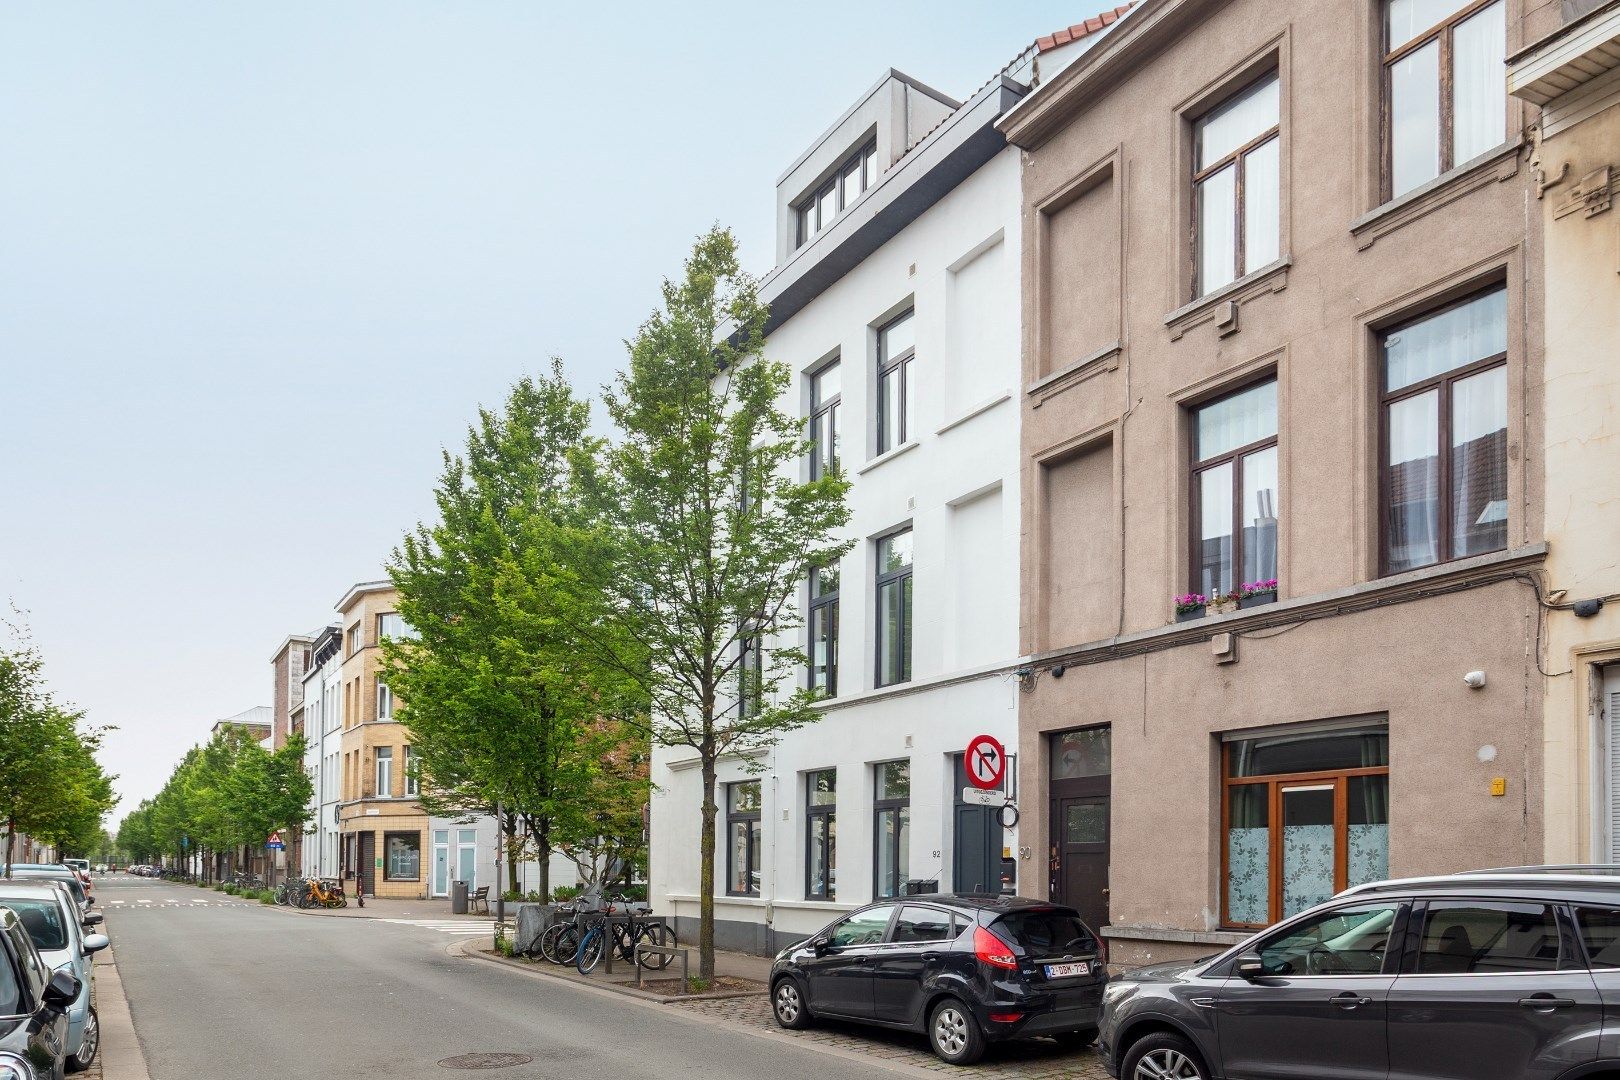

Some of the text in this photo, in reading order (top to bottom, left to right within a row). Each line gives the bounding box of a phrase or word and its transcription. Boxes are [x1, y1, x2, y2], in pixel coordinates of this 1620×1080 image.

[932, 850, 941, 858] 92
[1020, 846, 1031, 859] 90
[1051, 963, 1088, 976] 2-DBM-725
